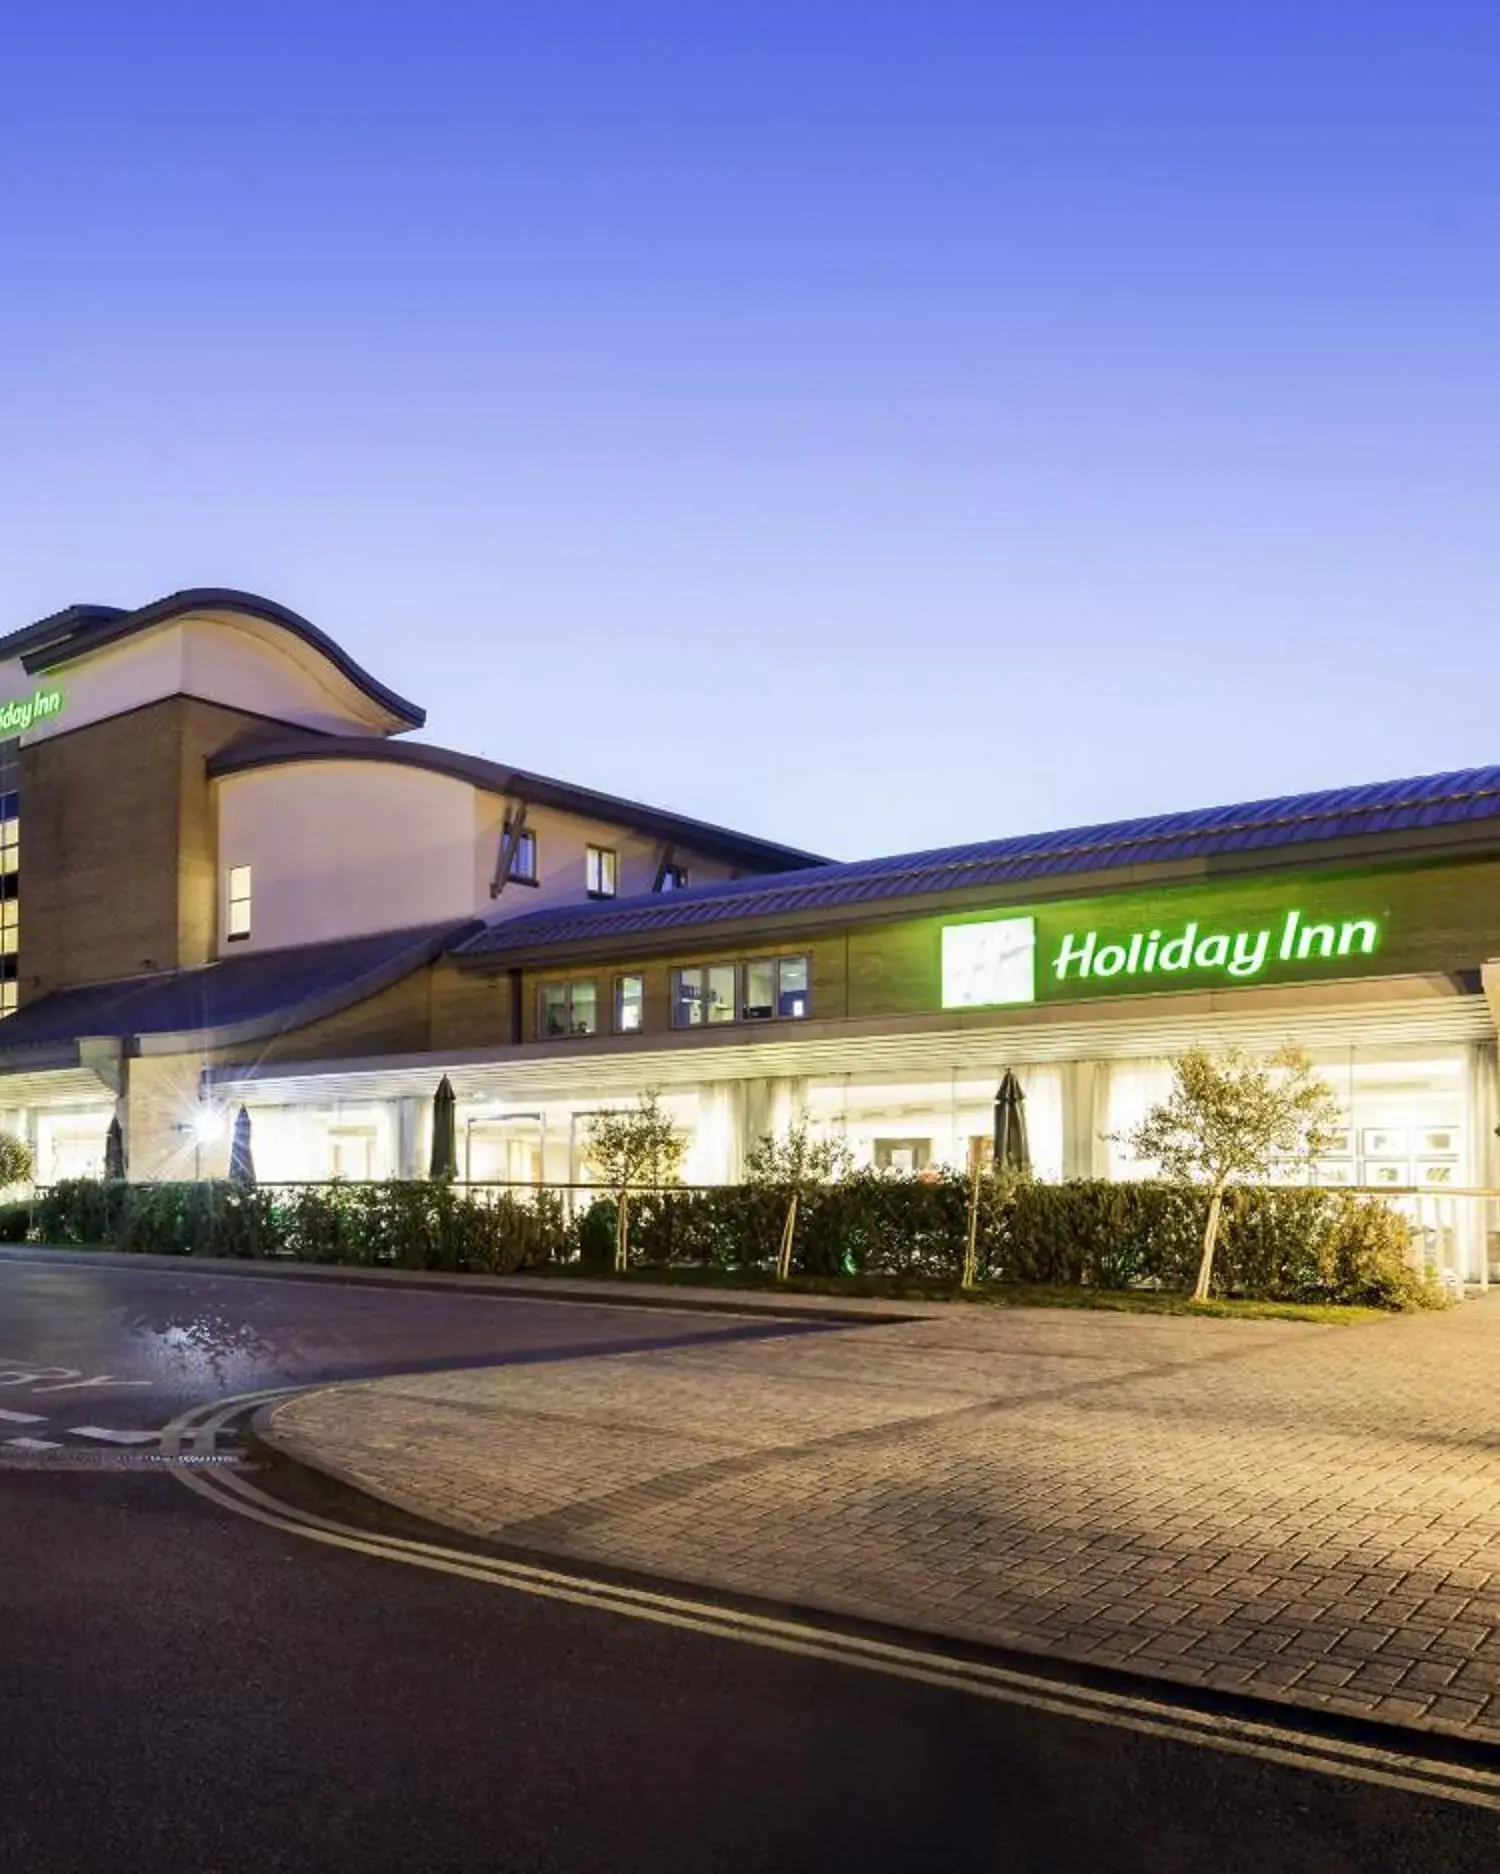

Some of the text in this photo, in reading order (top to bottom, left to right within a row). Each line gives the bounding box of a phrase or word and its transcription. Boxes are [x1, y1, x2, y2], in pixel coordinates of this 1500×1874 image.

[34, 691, 61, 717] Inn
[1051, 910, 1377, 978] Holiday Inn
